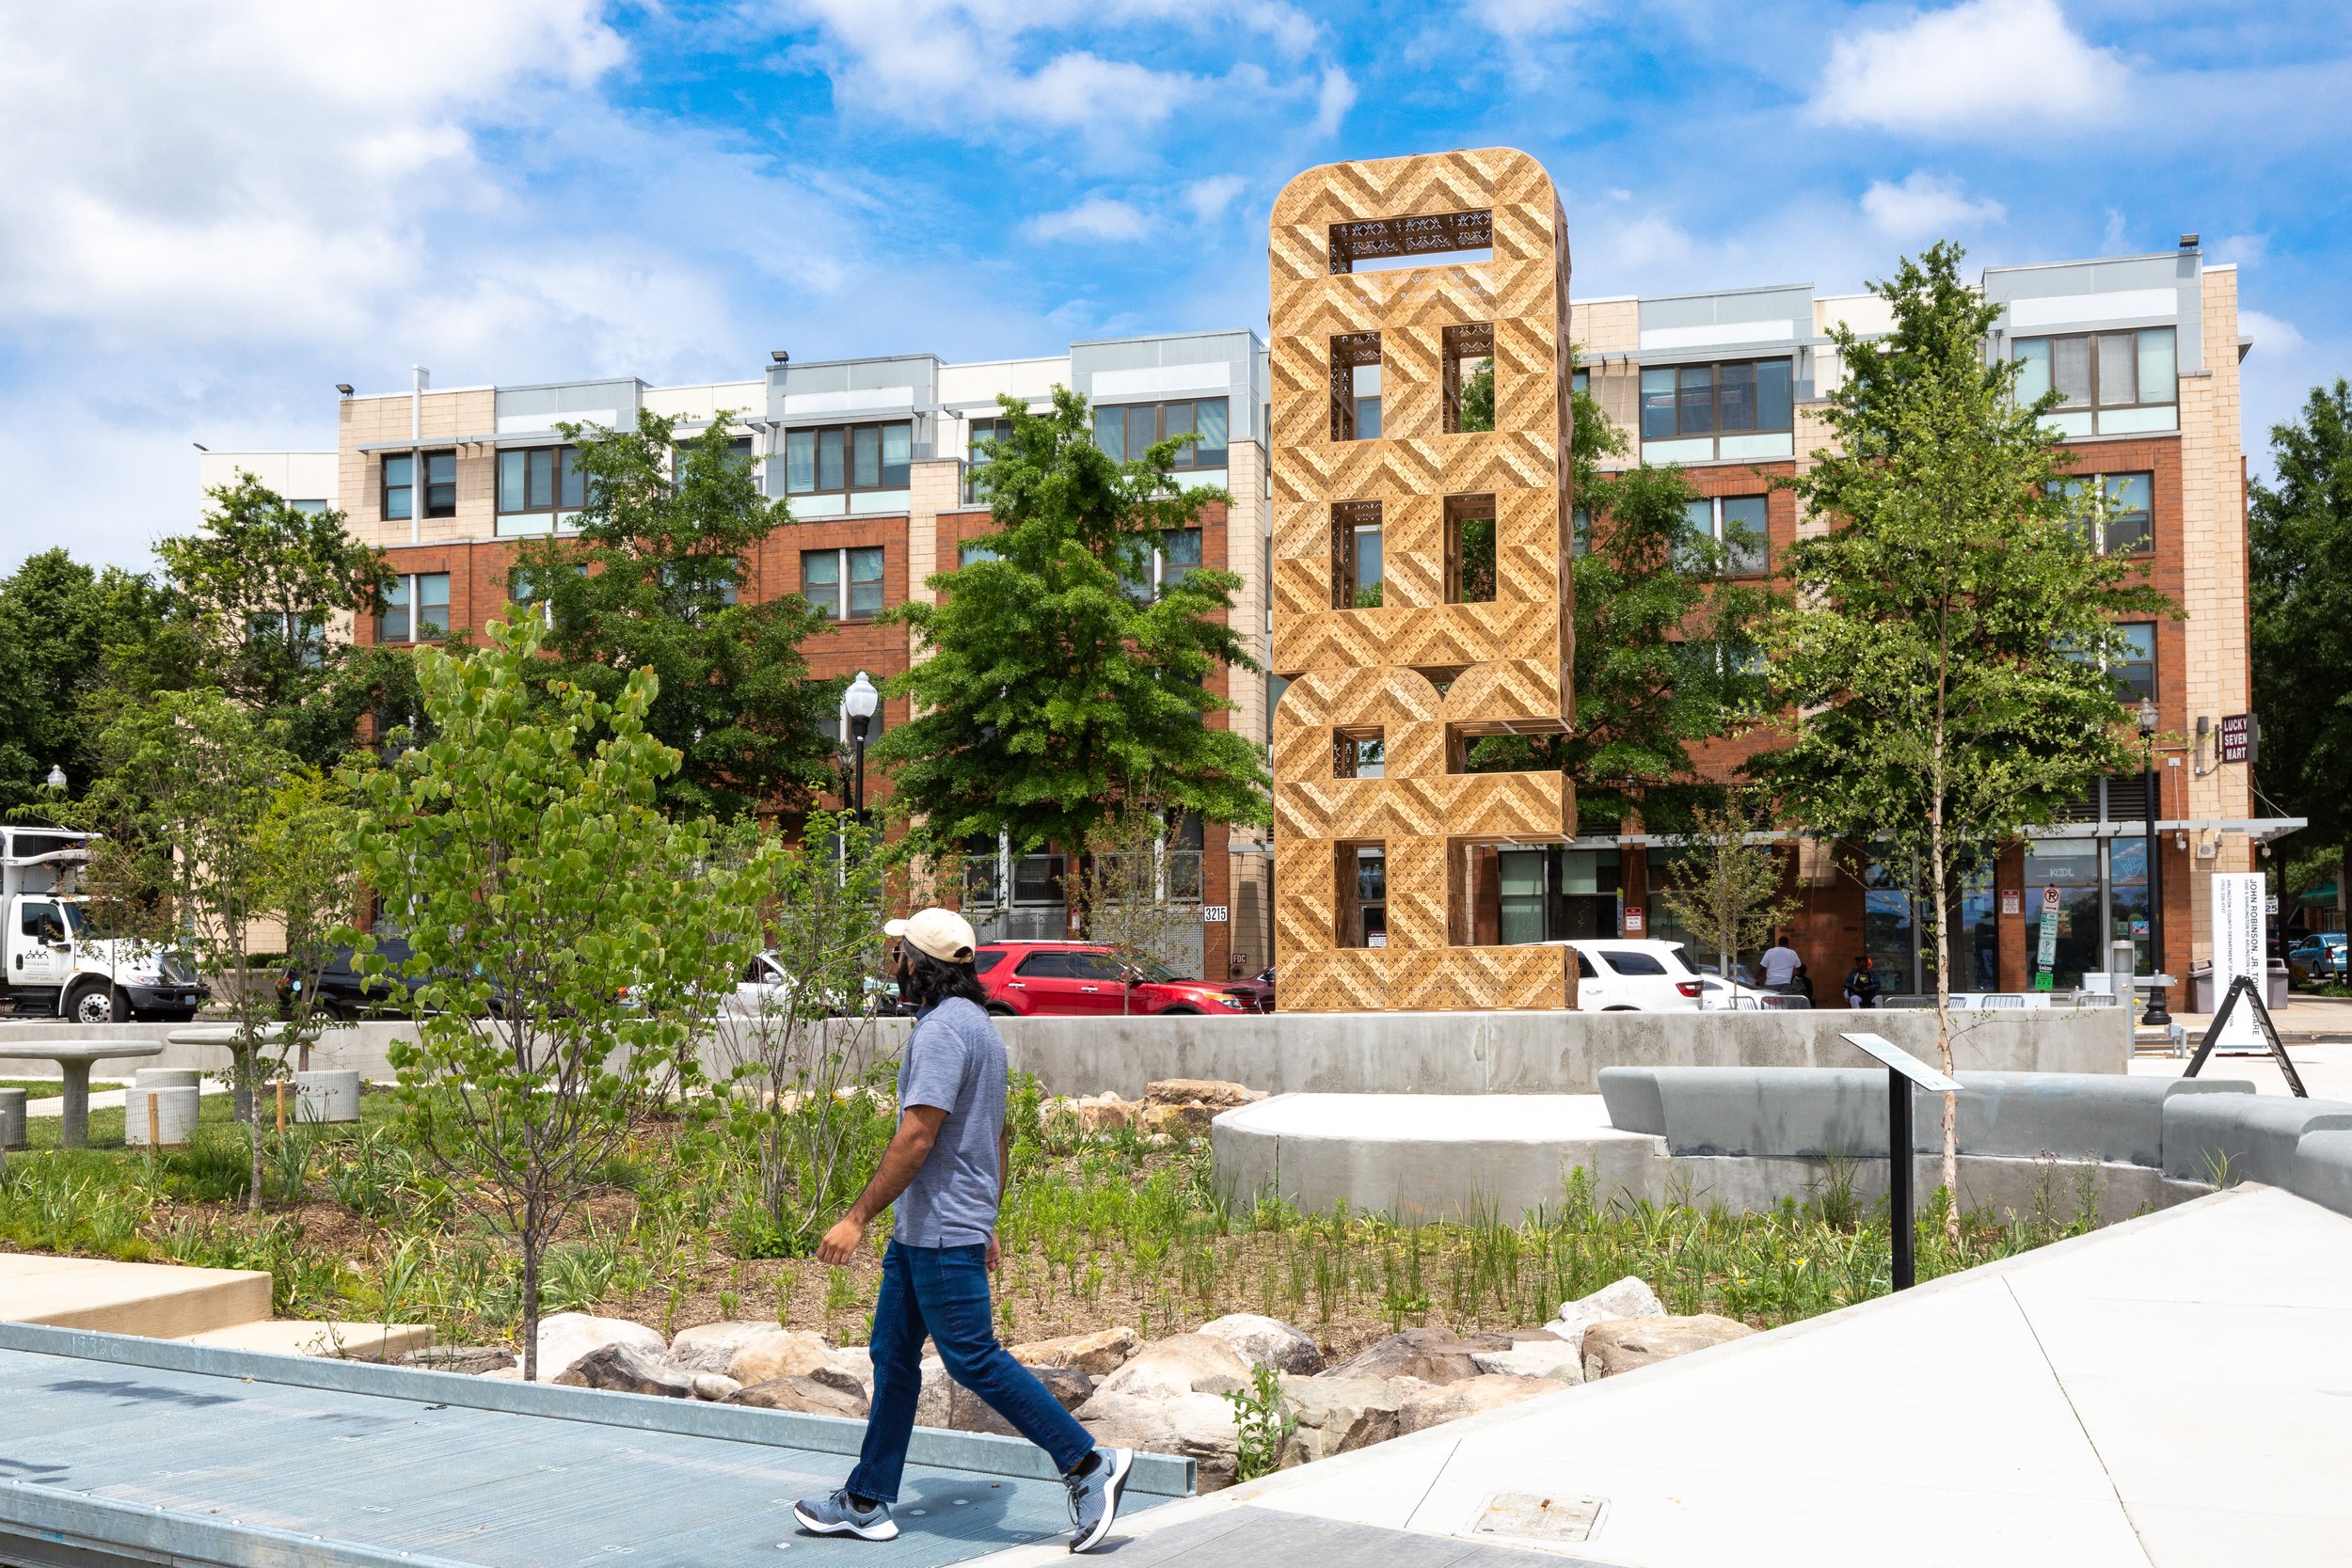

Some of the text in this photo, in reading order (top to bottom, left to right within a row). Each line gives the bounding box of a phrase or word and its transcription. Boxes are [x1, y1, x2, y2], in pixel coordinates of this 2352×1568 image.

[2224, 718, 2248, 732] LUCKY
[2224, 733, 2248, 746] SEVEN
[2226, 747, 2247, 760] MART
[2050, 867, 2074, 877] KOOL
[1205, 908, 1226, 920] 3215
[1233, 954, 1247, 962] FDC
